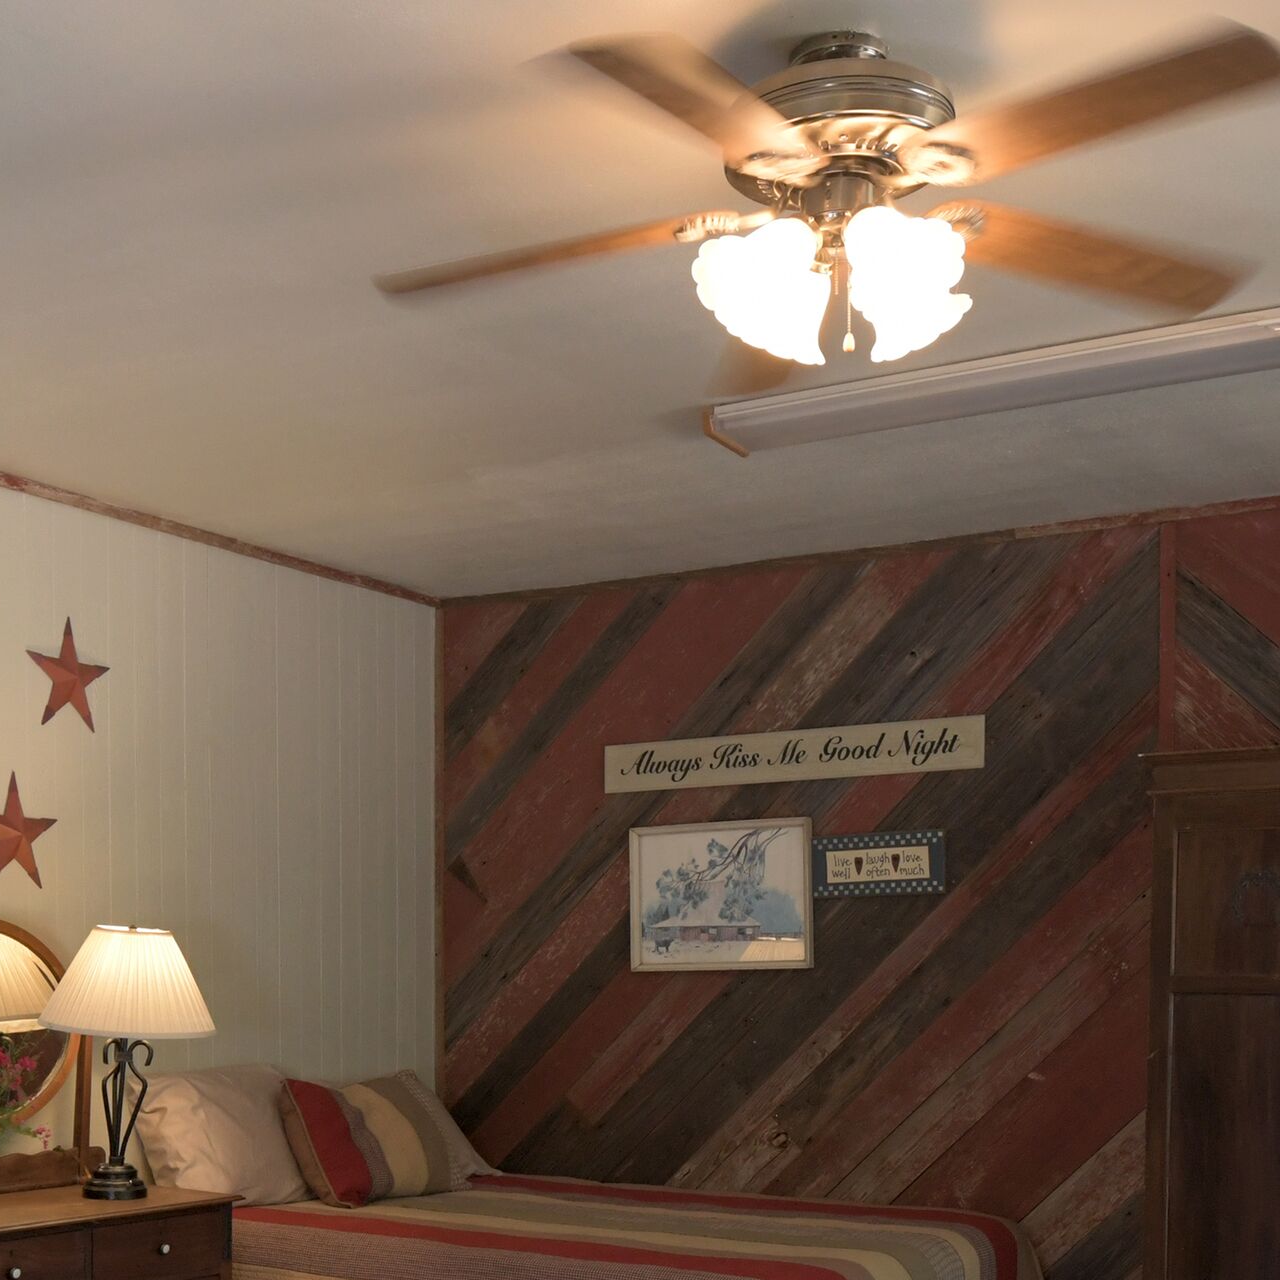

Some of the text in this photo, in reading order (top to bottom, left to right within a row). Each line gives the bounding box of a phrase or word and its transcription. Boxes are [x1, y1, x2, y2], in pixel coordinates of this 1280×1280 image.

[620, 727, 961, 782] Always Kiss Me Good Night
[865, 851, 890, 867] laugh
[831, 863, 926, 880] well often much
